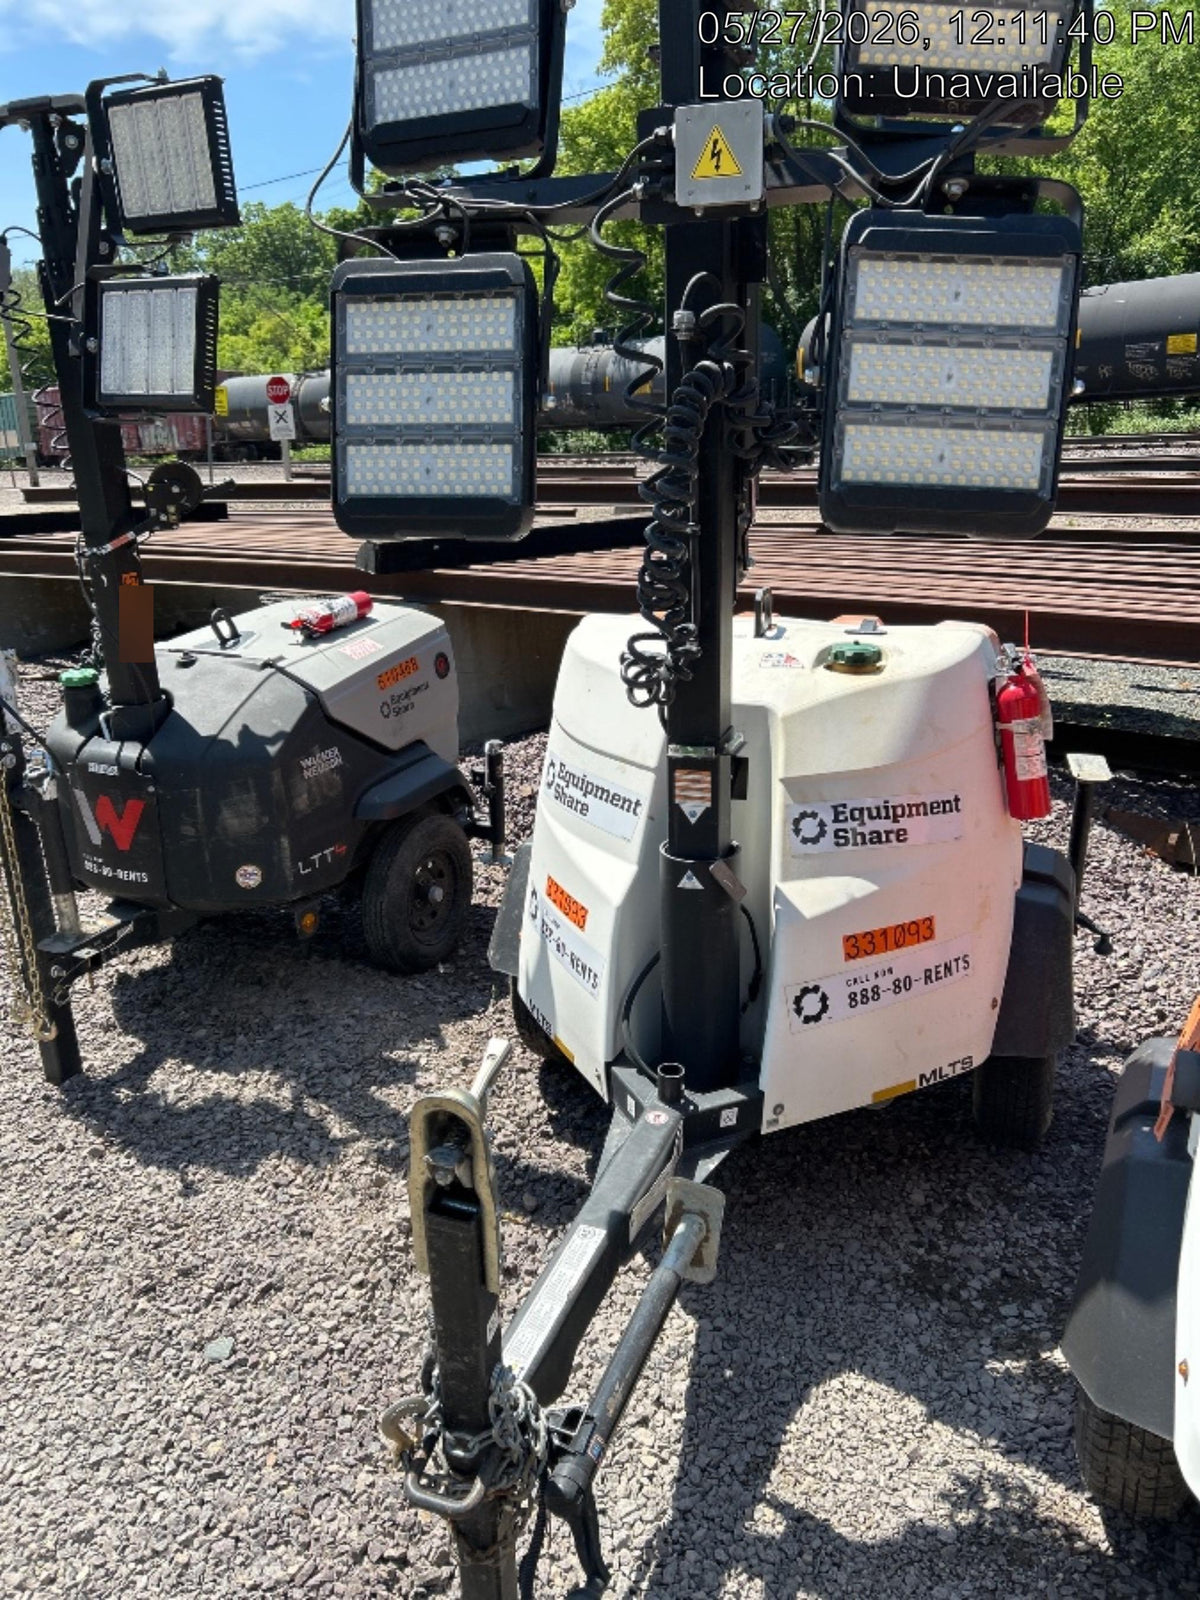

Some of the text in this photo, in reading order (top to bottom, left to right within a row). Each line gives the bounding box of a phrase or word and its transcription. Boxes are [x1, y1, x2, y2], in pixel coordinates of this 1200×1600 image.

[268, 385, 288, 396] STOP
[554, 783, 589, 816] Share
[557, 762, 642, 817] Equipment
[831, 795, 961, 827] Equipment
[832, 827, 908, 847] Share
[845, 917, 935, 960] 331093
[848, 954, 970, 1008] 888-80-RENTS
